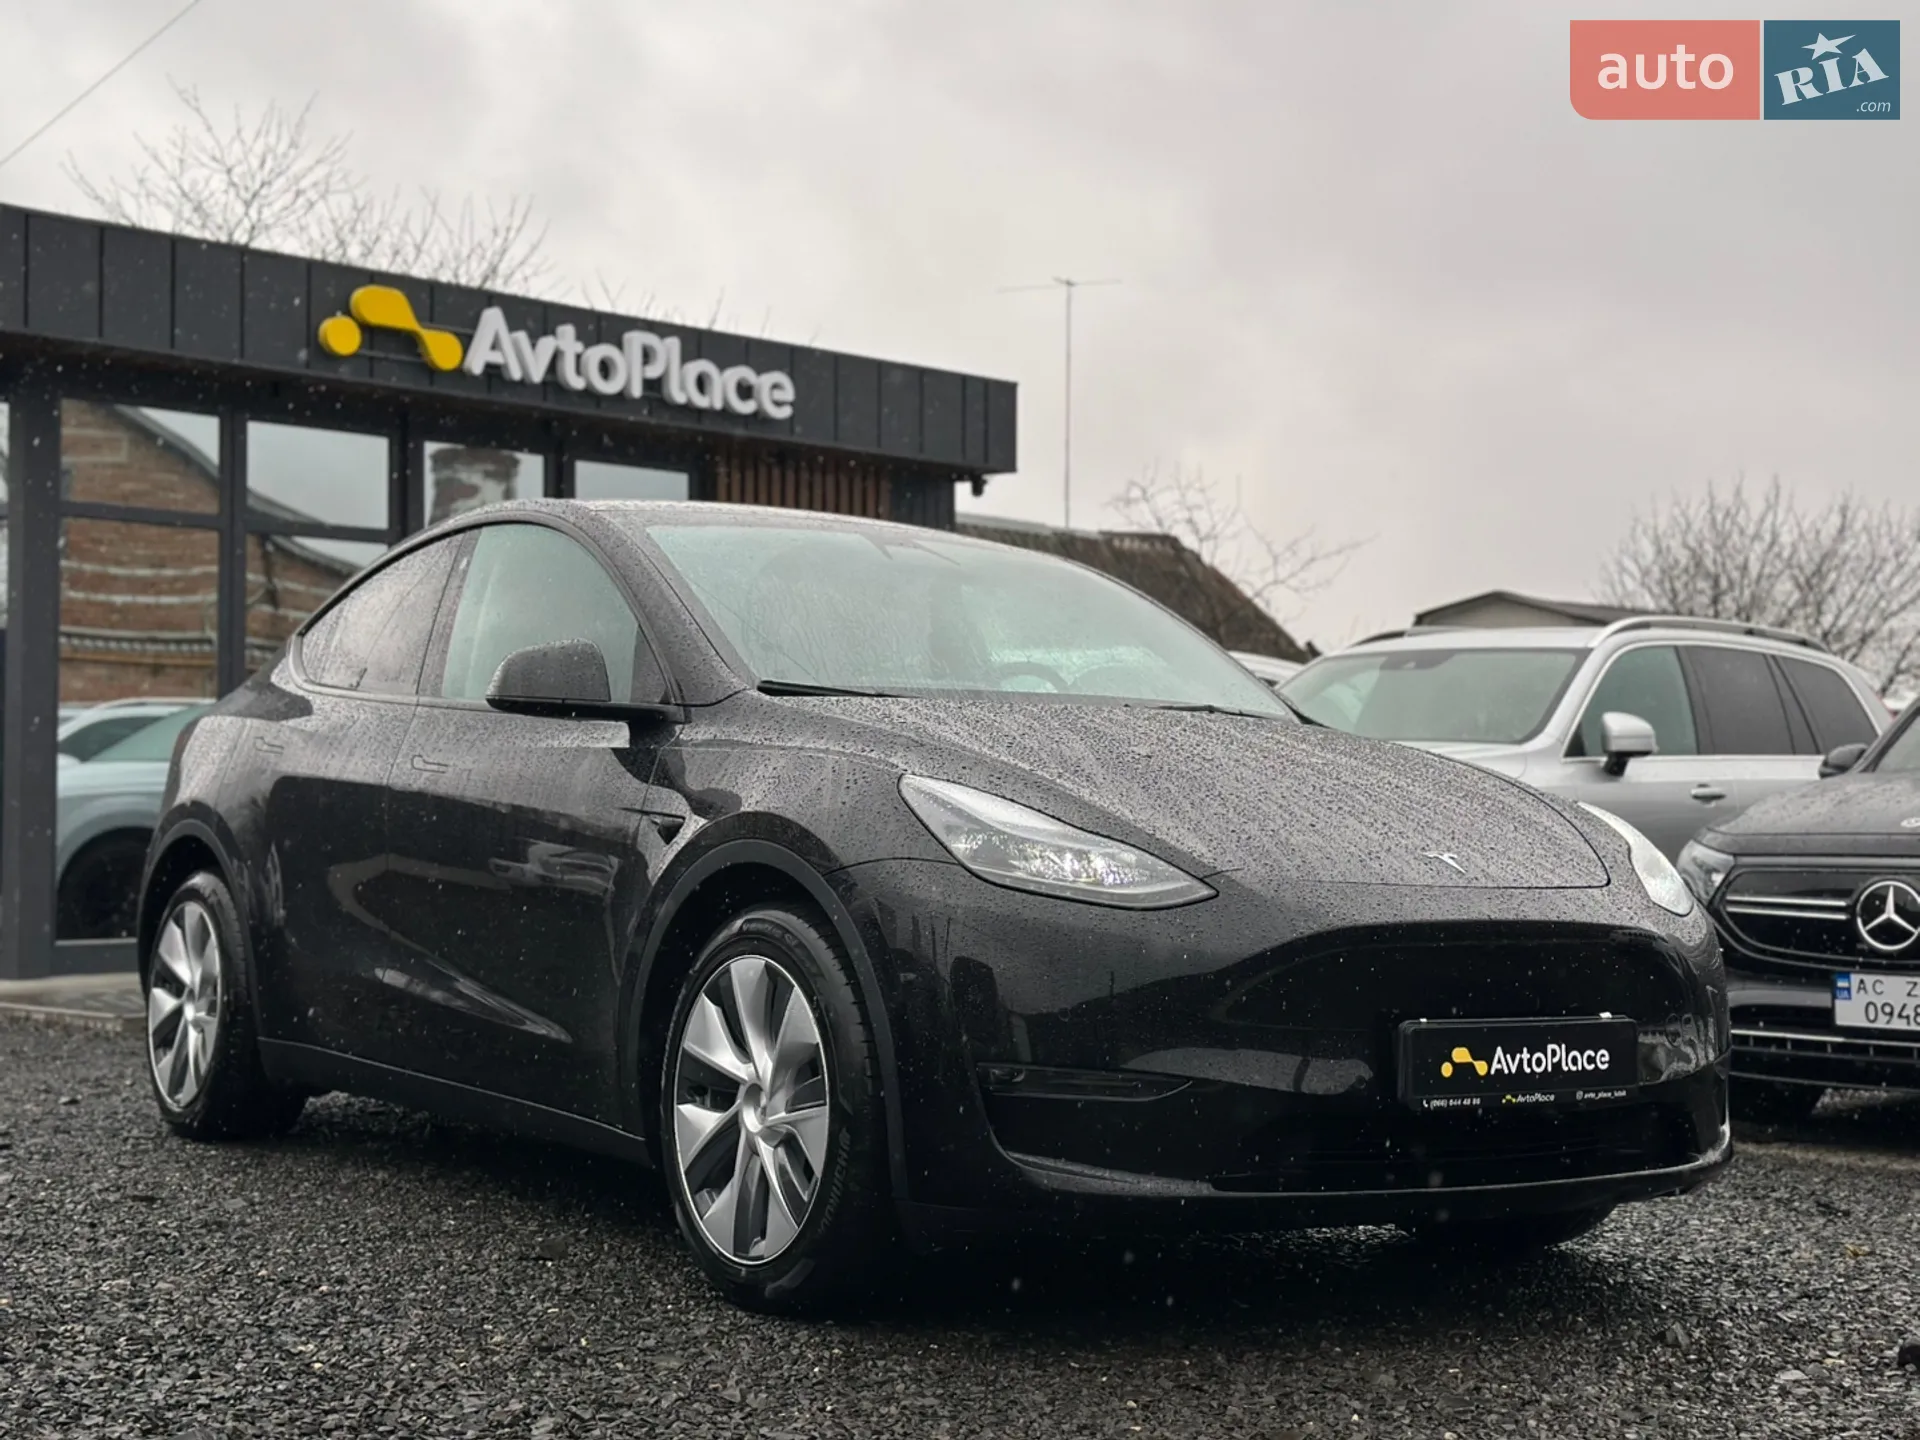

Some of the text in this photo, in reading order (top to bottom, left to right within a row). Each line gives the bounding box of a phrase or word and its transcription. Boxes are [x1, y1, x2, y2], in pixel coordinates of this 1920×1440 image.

[462, 306, 796, 420] AvtoPlace
[1836, 989, 1850, 999] UA
[1856, 978, 1884, 995] AC
[1490, 1044, 1610, 1075] AvtoPlace
[1516, 1092, 1555, 1104] AvtoPlace
